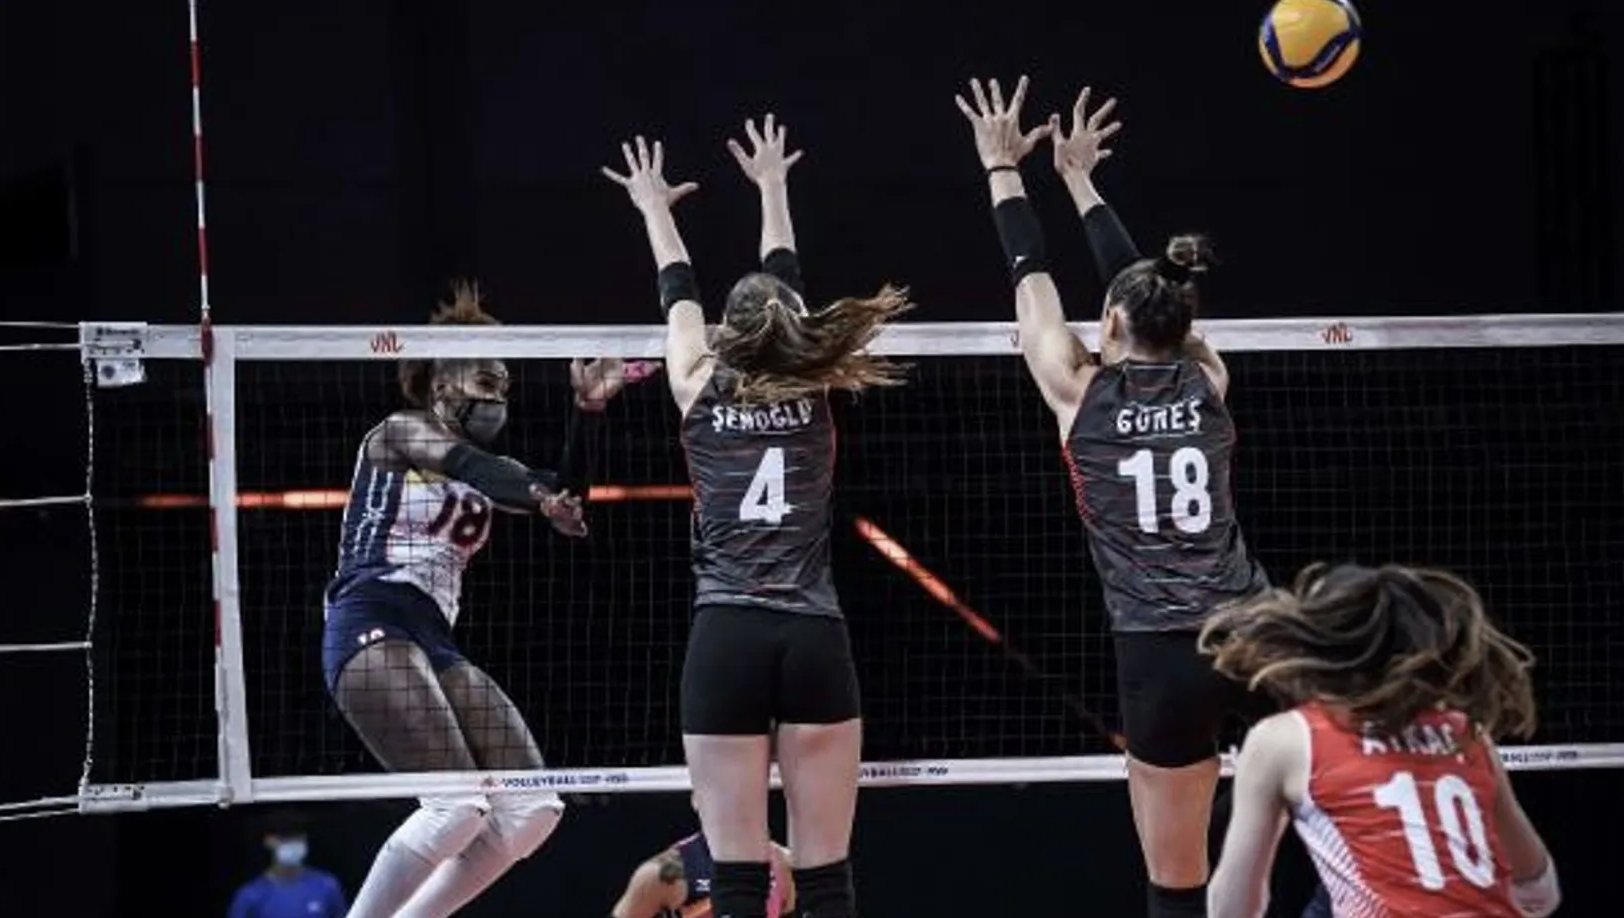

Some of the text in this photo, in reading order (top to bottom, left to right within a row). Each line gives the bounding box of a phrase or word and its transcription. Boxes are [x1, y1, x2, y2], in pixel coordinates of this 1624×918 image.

[370, 331, 404, 354] VNL
[1321, 322, 1354, 344] VNL
[427, 490, 491, 547] 18
[739, 447, 792, 524] 4
[1118, 446, 1212, 533] 18
[1373, 771, 1496, 890] 10
